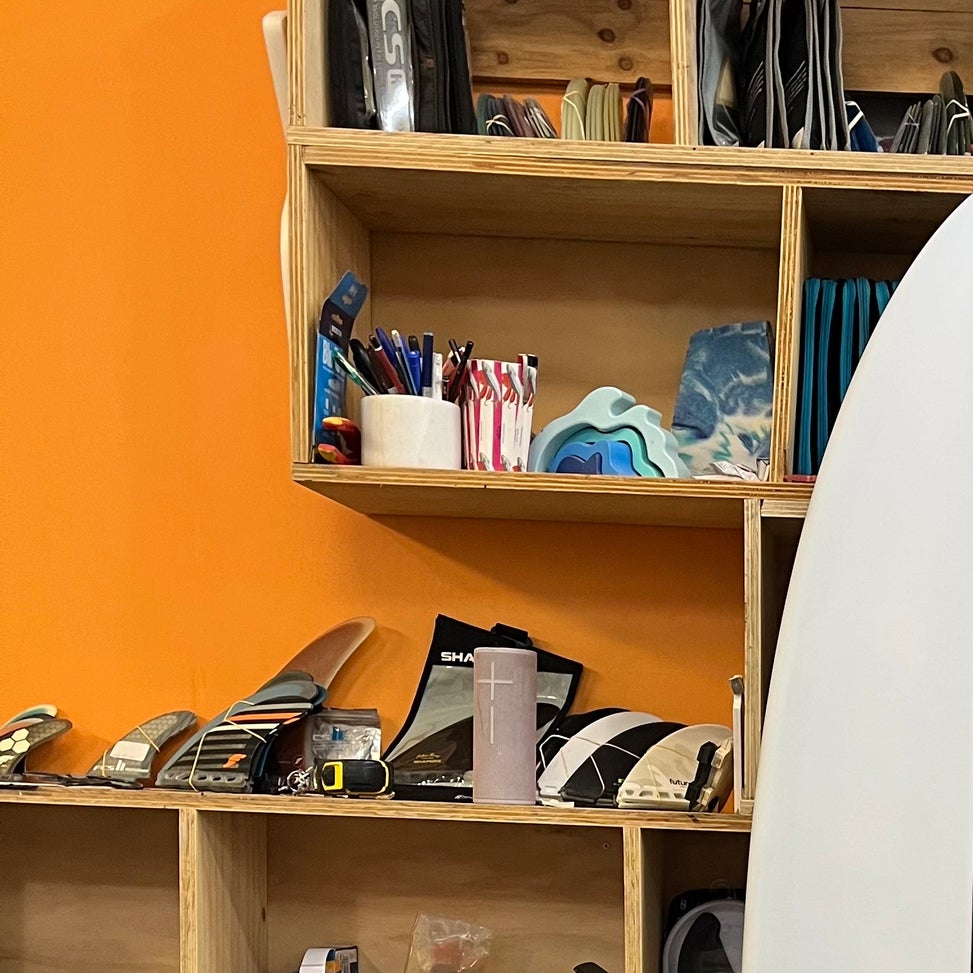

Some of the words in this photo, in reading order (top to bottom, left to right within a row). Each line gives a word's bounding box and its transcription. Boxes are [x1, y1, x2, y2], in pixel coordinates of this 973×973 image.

[381, 0, 405, 65] CS
[440, 651, 475, 662] SHA
[669, 778, 689, 786] futur
